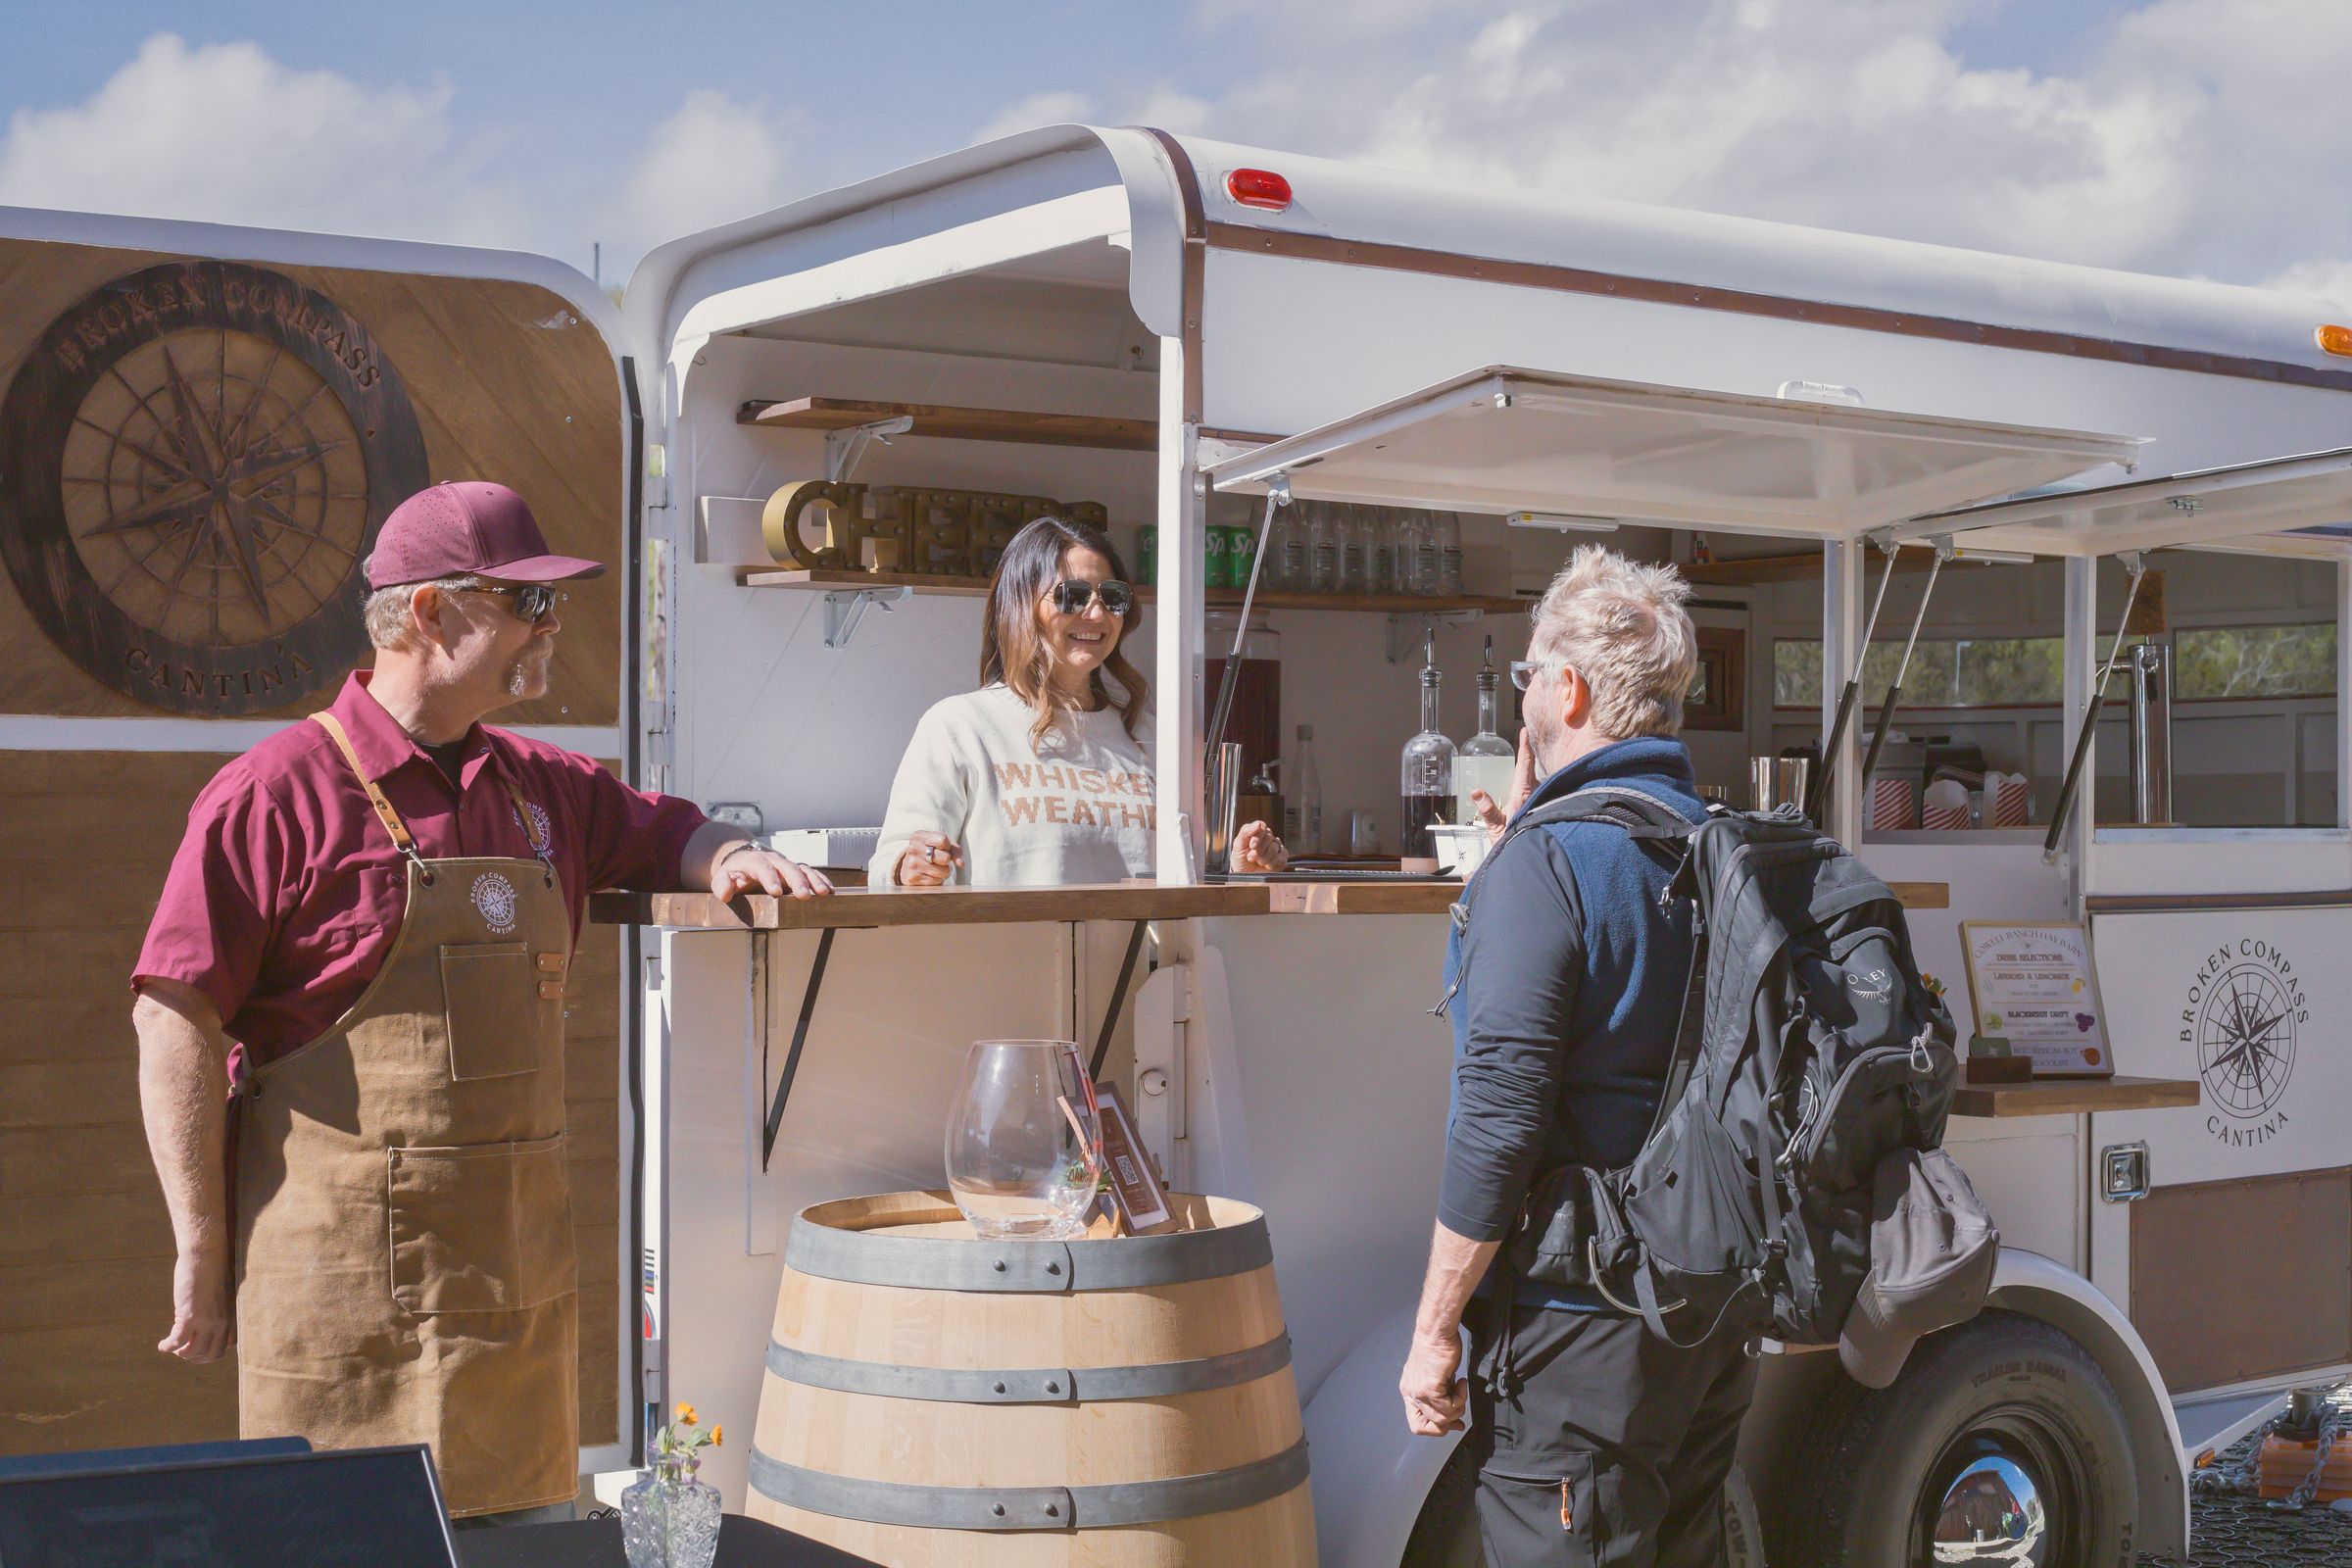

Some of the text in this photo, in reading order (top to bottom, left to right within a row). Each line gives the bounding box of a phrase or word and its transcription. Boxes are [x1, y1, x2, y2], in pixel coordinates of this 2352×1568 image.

[54, 272, 381, 389] BROKEN COMPASS
[762, 479, 1107, 572] CHEE
[124, 648, 313, 696] CANTINA
[992, 761, 1153, 797] WHISKE
[1000, 796, 1156, 831] WEATH
[470, 872, 486, 904] BROKEN
[486, 922, 516, 935] CANTINA
[2180, 938, 2309, 1043] BROKEN COMPASS
[2207, 1110, 2289, 1147] CANTINA
